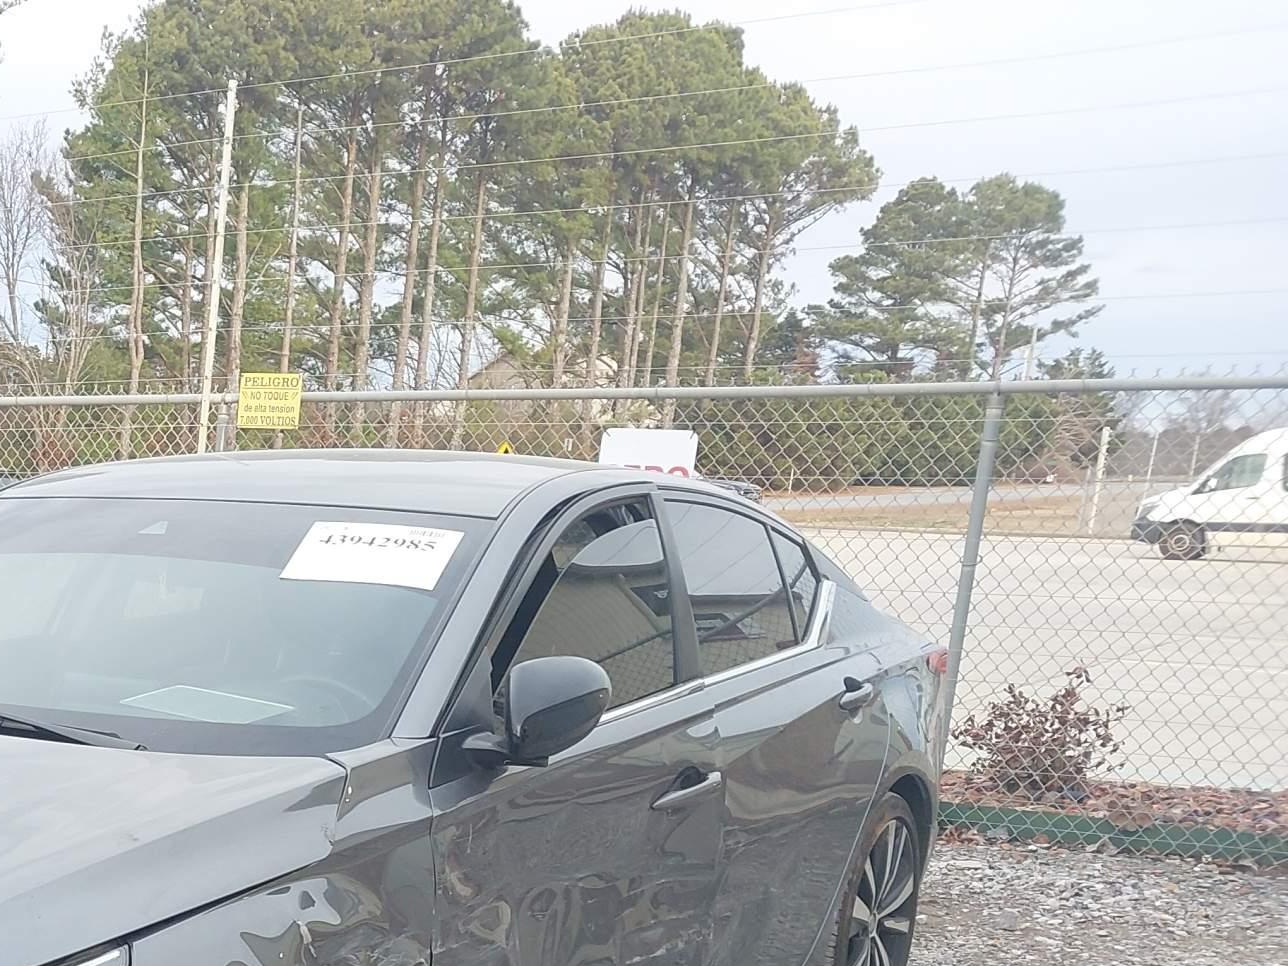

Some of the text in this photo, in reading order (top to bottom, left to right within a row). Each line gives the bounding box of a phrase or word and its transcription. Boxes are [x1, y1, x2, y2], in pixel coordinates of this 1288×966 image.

[244, 377, 299, 388] PELIGRO
[250, 391, 289, 401] NO TOQUE
[244, 403, 253, 412] de
[254, 403, 267, 413] alta
[260, 416, 296, 426] VOLTIOS
[319, 534, 437, 552] 43942985
